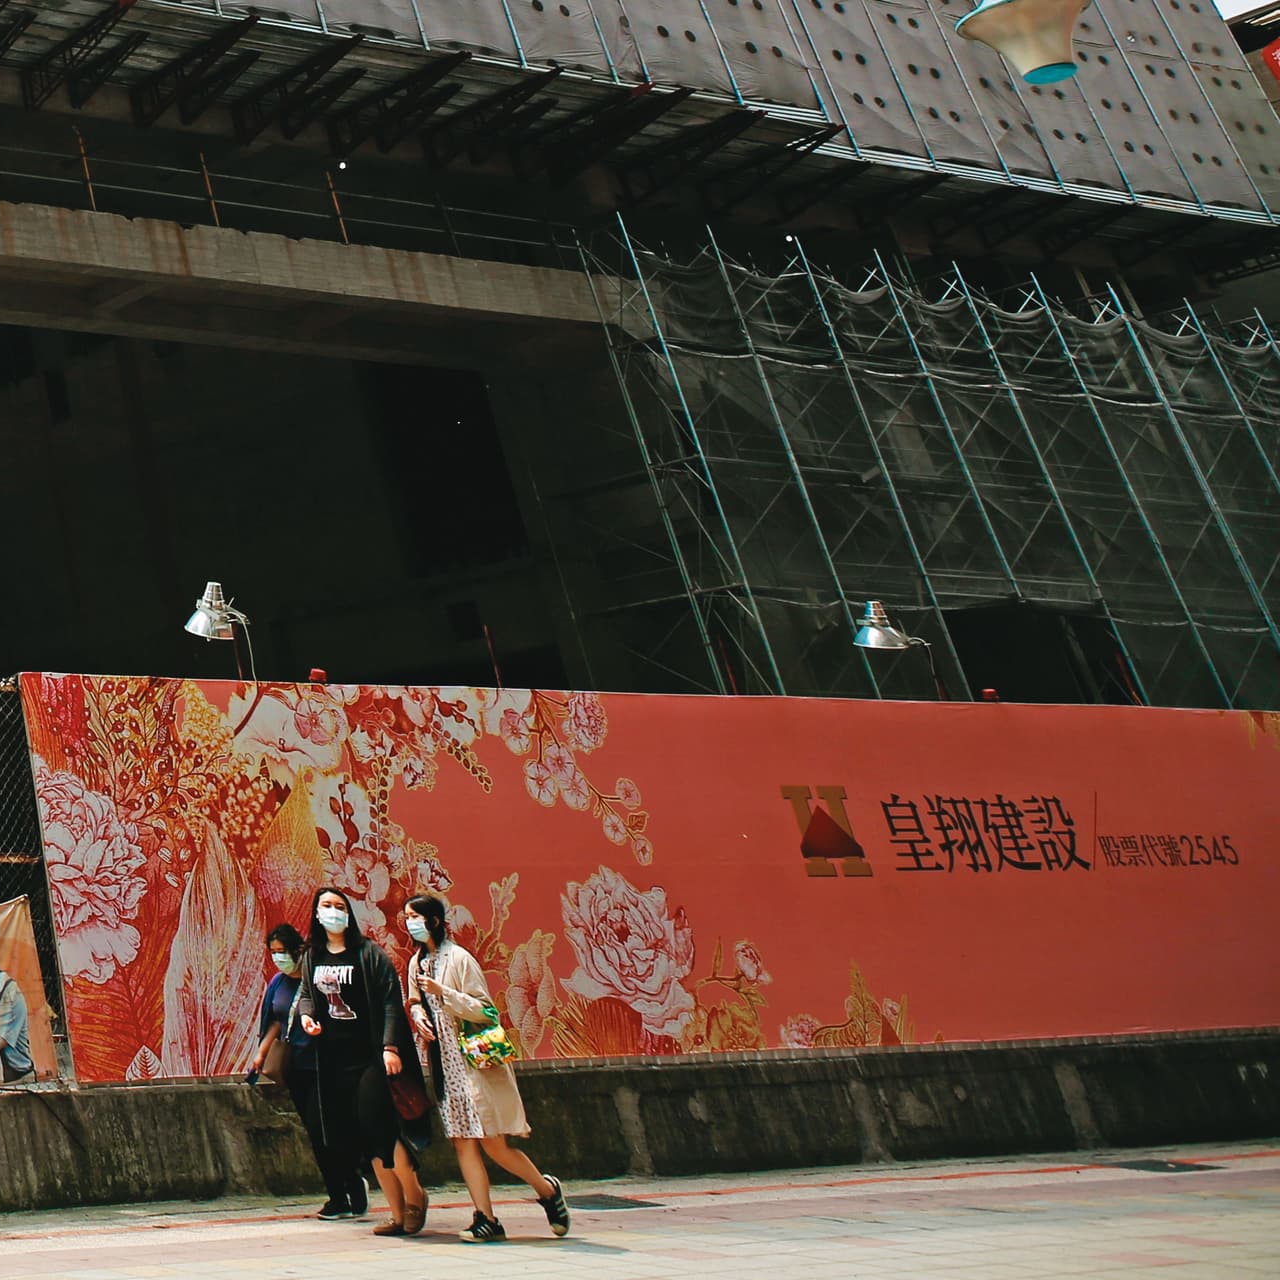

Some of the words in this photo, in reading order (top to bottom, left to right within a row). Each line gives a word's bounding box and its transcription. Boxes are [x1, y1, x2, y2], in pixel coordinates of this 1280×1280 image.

[880, 794, 1091, 872] 皇翔建設
[1098, 834, 1239, 867] 股票代號2545
